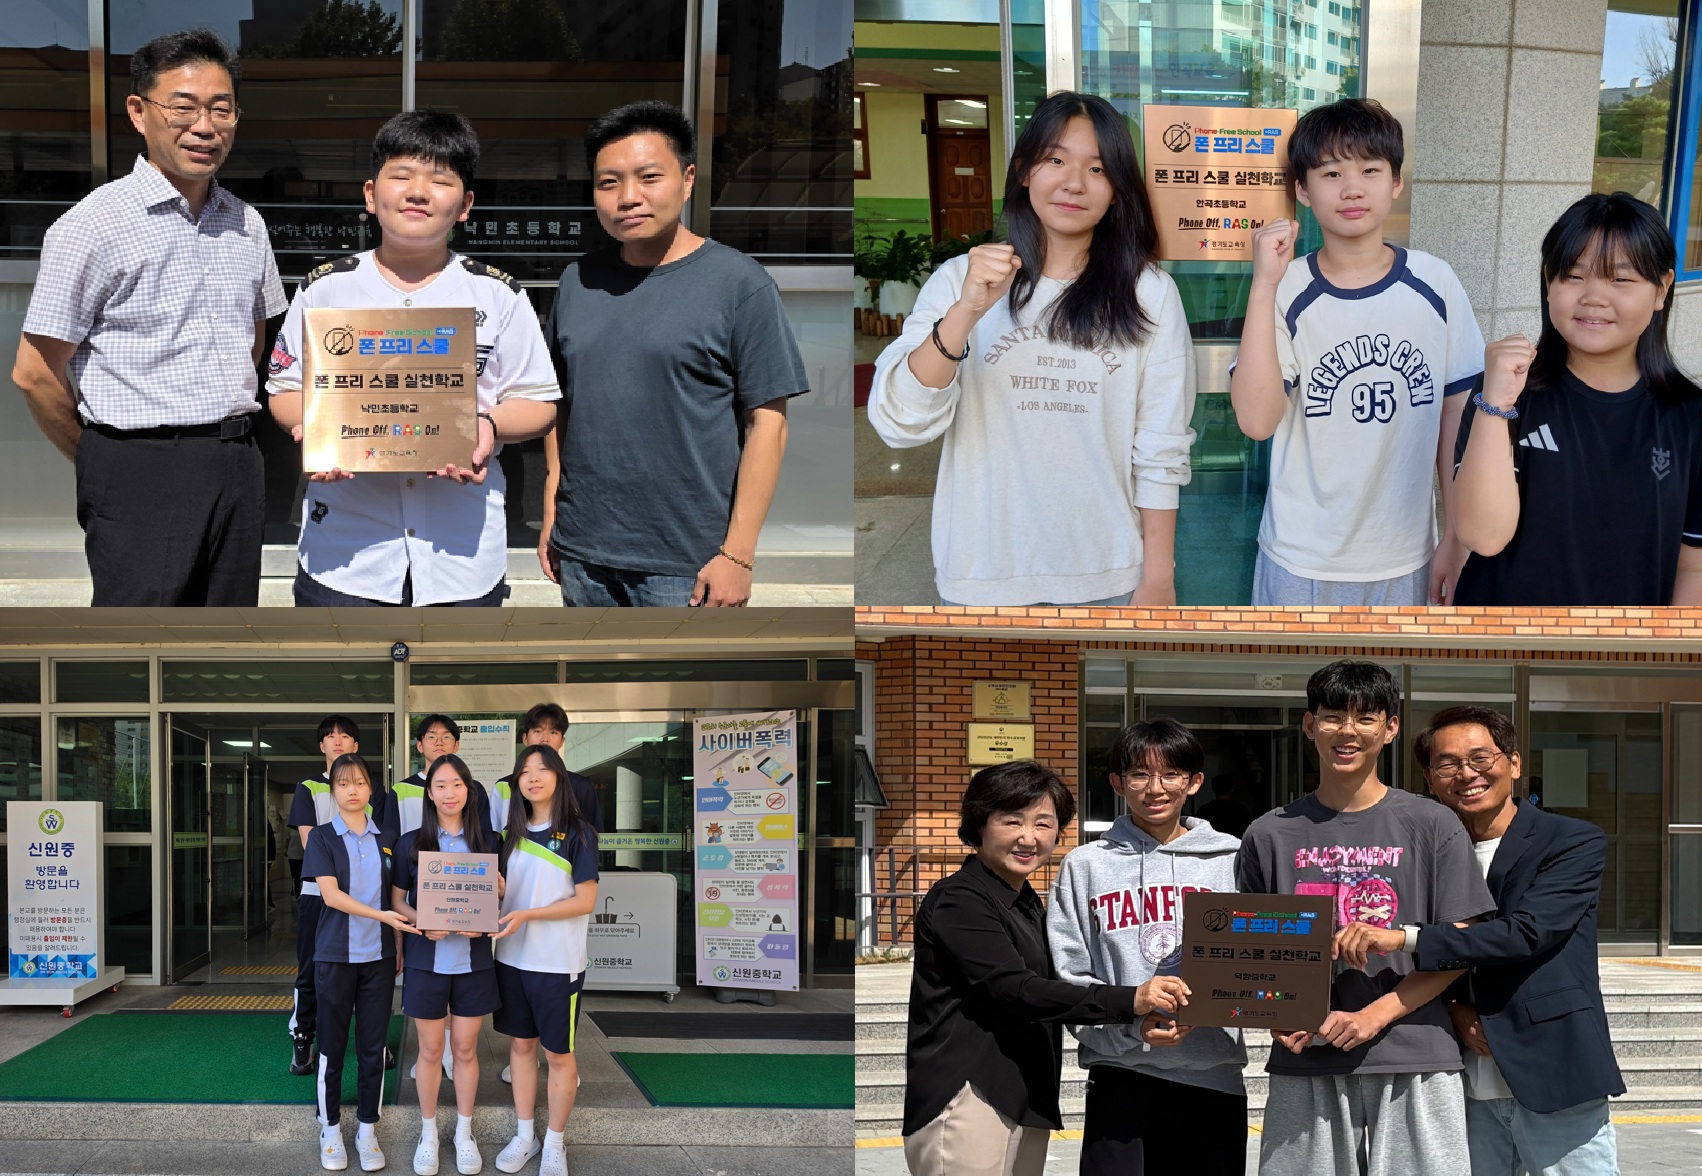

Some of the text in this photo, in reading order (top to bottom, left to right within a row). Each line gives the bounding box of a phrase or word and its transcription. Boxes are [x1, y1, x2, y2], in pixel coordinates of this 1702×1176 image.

[1194, 136, 1274, 154] 폰 프리 스쿨
[1154, 169, 1287, 186] 폰 프리 스쿨 실천학교
[1196, 199, 1246, 208] 안곡초등학교
[464, 222, 582, 236] 낙민초등학교
[1178, 218, 1204, 228] Phone
[1224, 218, 1248, 229] RAS
[1250, 220, 1264, 229] On!
[358, 338, 450, 355] 폰 프리 스쿨
[984, 325, 1047, 365] SANTA
[314, 373, 464, 388] 폰 프리 스쿨 실천학교
[1305, 334, 1434, 418] LEGENDS CREW
[1010, 375, 1098, 394] WHITE FOX
[1352, 381, 1396, 423] 95
[360, 404, 420, 414] 낙민초등학교
[342, 424, 370, 436] Phone
[392, 424, 422, 436] RAS
[425, 424, 440, 436] On!
[480, 724, 510, 733] 출입수칙
[698, 728, 792, 752] 사이버폭력
[28, 842, 76, 858] 신원중
[36, 866, 68, 876] 방문을
[453, 867, 468, 875] 프리
[470, 868, 486, 876] 스쿨
[25, 879, 80, 890] 환영합니다
[1232, 918, 1311, 935] 폰 프리 스쿨
[1192, 946, 1322, 962] 폰 프리 스쿨 실천학교
[39, 962, 83, 970] 신원중학교
[594, 958, 632, 966] 신원중학교
[732, 968, 782, 980] 신원중학교
[1234, 972, 1276, 981] 덕양중학교
[1212, 989, 1236, 998] Phone
[1257, 990, 1282, 1001] RAS
